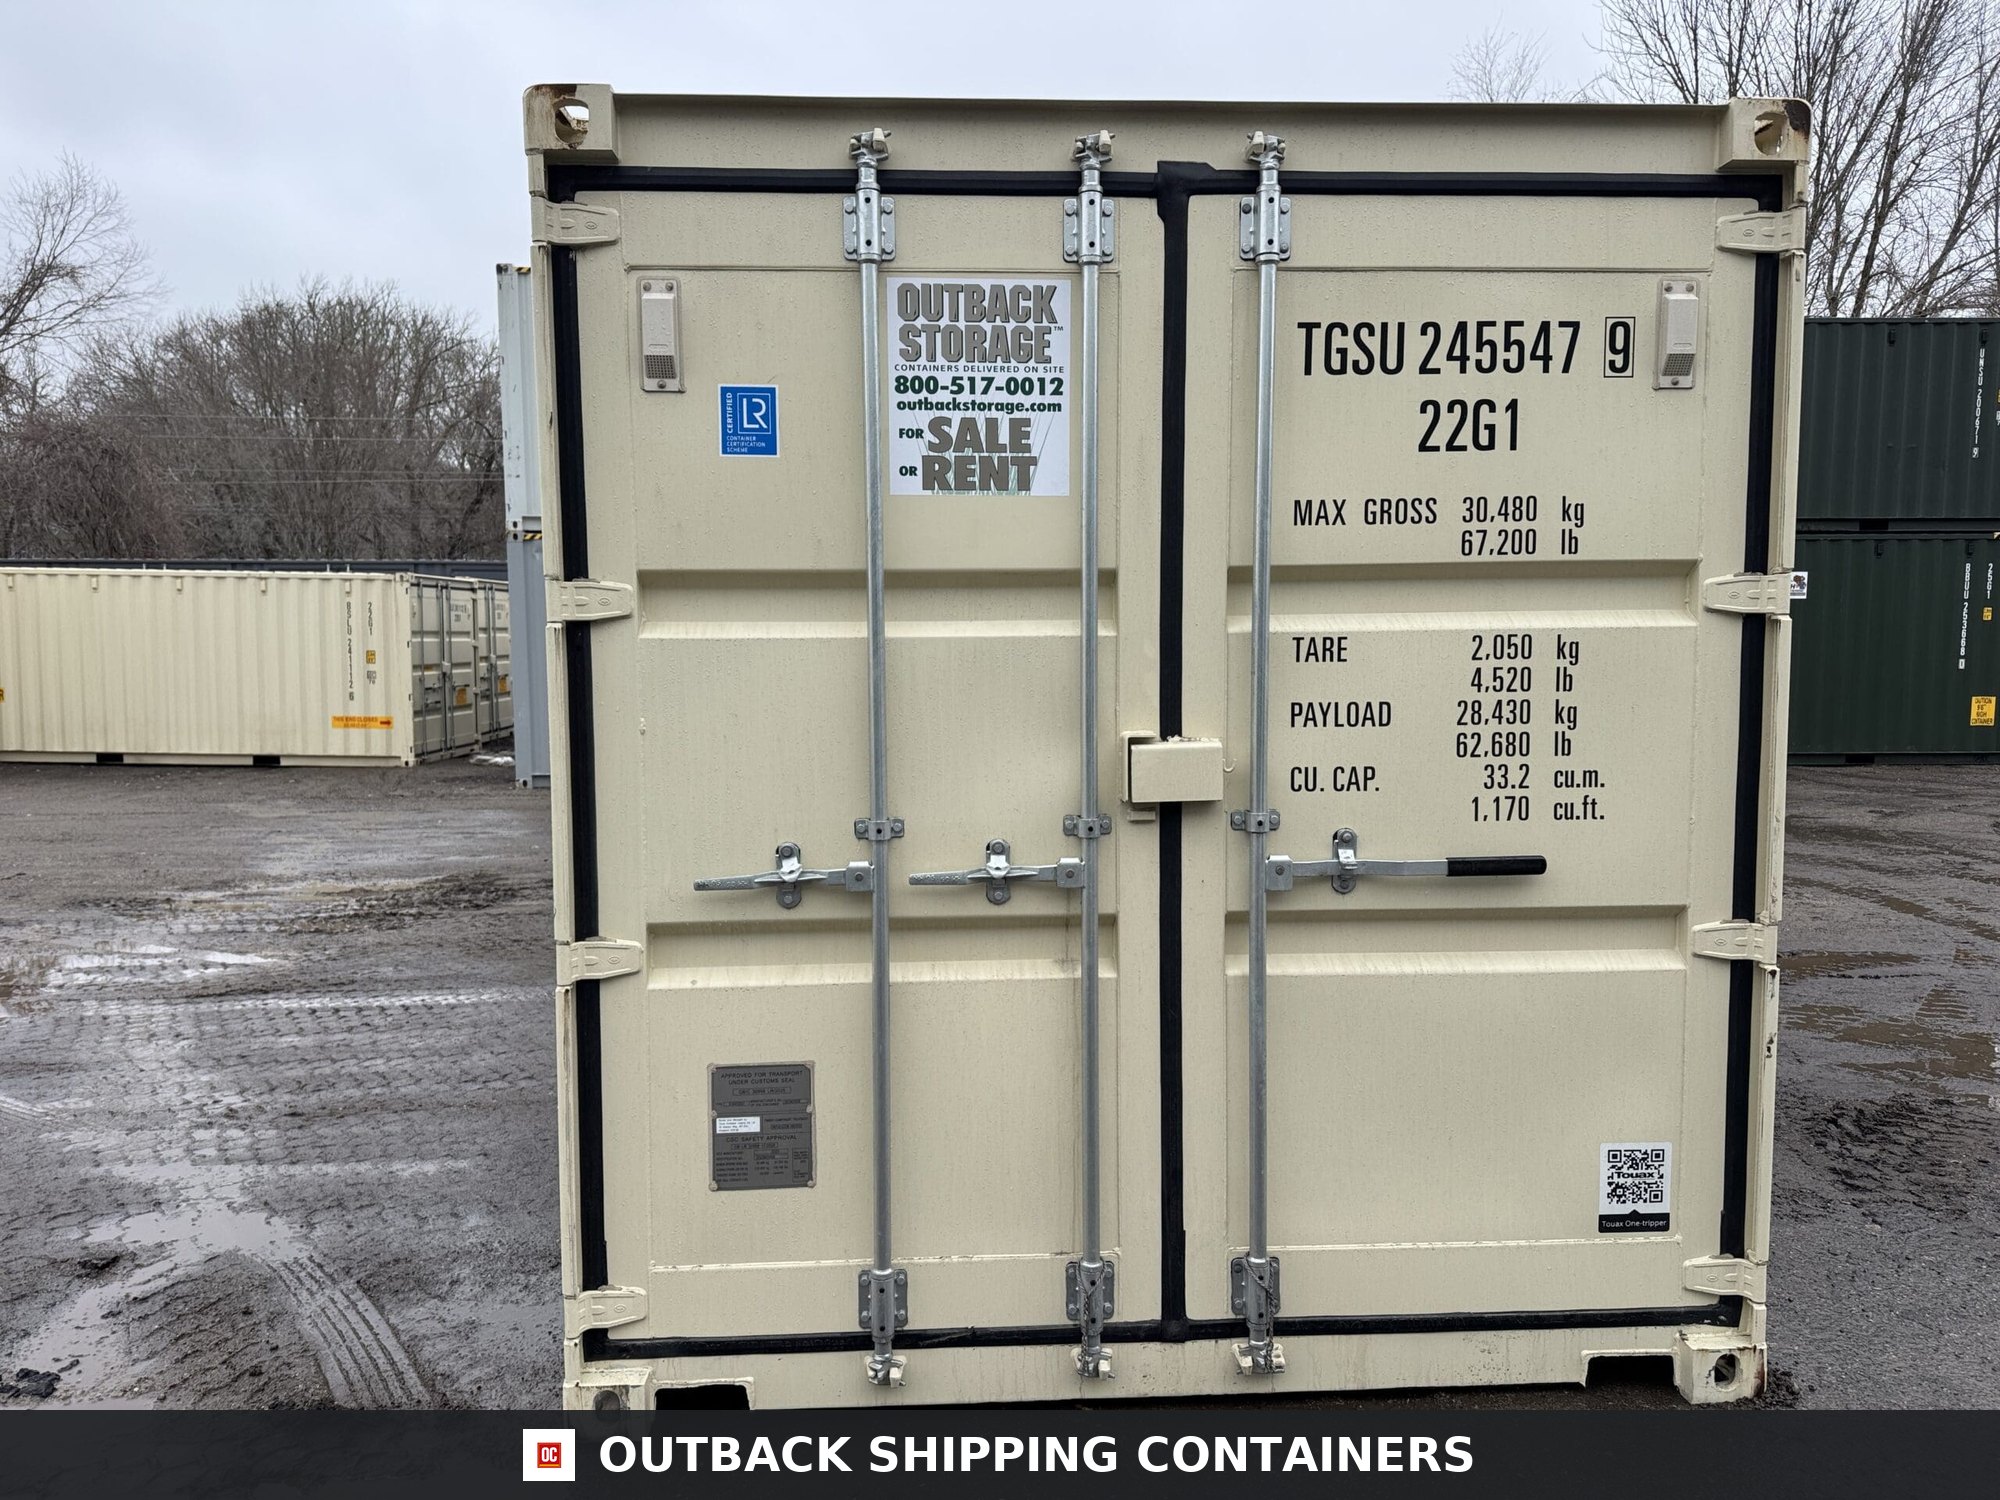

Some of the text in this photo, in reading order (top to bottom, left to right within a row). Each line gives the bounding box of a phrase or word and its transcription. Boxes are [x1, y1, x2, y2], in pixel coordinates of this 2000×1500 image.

[897, 283, 1058, 324] OUTBACK
[898, 324, 1052, 364] STORAGE
[1297, 320, 1631, 375] TGSU 245547 9
[894, 364, 1065, 374] CONTAINERS DELIVERED ON SITE
[894, 375, 1064, 396] 800-517-0012
[743, 398, 768, 428] LR
[896, 397, 1062, 414] outbackstorage.com
[1975, 389, 1983, 444] 200671
[898, 416, 1032, 454] FOR SALE
[1419, 399, 1518, 452] 22G1
[899, 455, 1038, 491] OR RENT
[1293, 496, 1585, 531] MAX GROSS 30,480 kg
[1461, 528, 1579, 556] 67,200 lb
[1292, 634, 1580, 665] TARE 2,050 kg
[1470, 667, 1573, 693] 4,520 lb
[1291, 699, 1578, 730] PAYLOAD 28,430 kg
[1456, 731, 1572, 758] 62,680 lb
[1290, 764, 1605, 792] CU. CAP. 33.2 cu.m.
[1471, 796, 1605, 822] 1,170 cu.ft.
[1625, 1219, 1667, 1228] One-tripper
